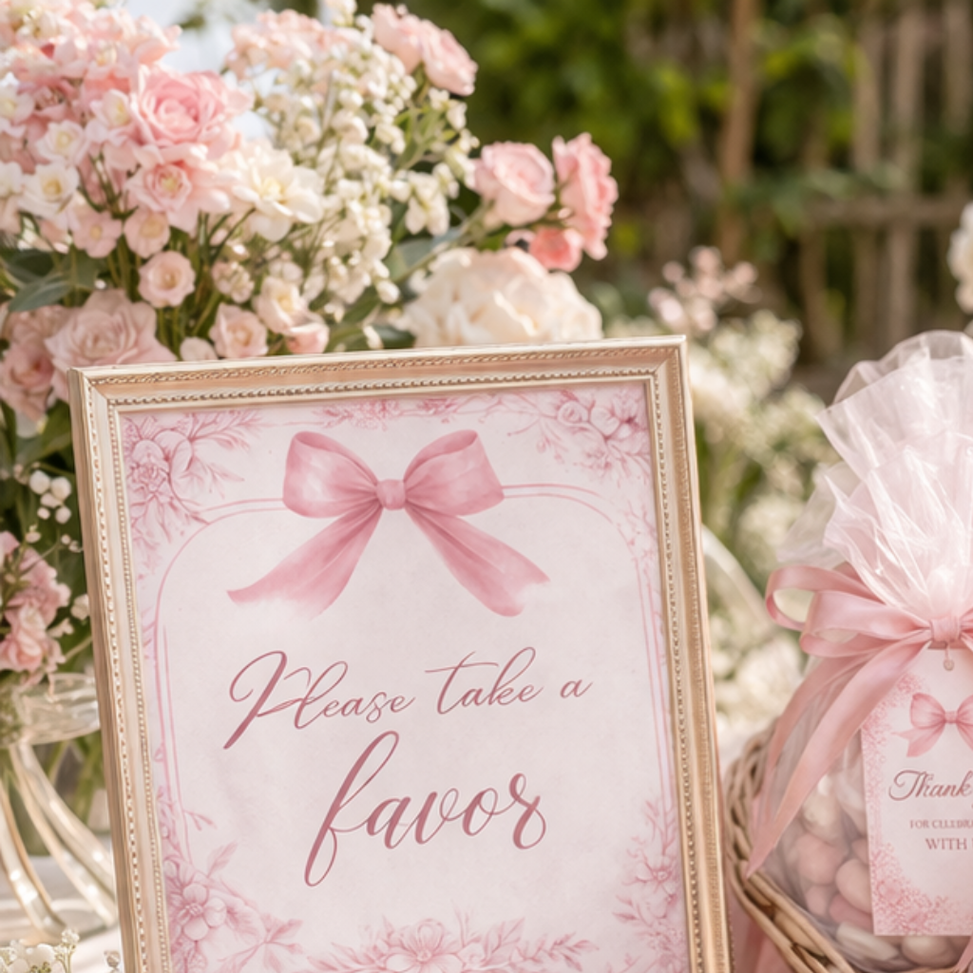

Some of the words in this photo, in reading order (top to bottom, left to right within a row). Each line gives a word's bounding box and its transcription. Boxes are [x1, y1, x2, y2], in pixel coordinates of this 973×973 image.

[223, 650, 416, 750] Please
[424, 646, 544, 715] take
[559, 678, 593, 700] a
[888, 770, 973, 801] Thank
[303, 730, 547, 887] favor
[909, 819, 930, 829] FOR
[925, 837, 968, 850] WITH
